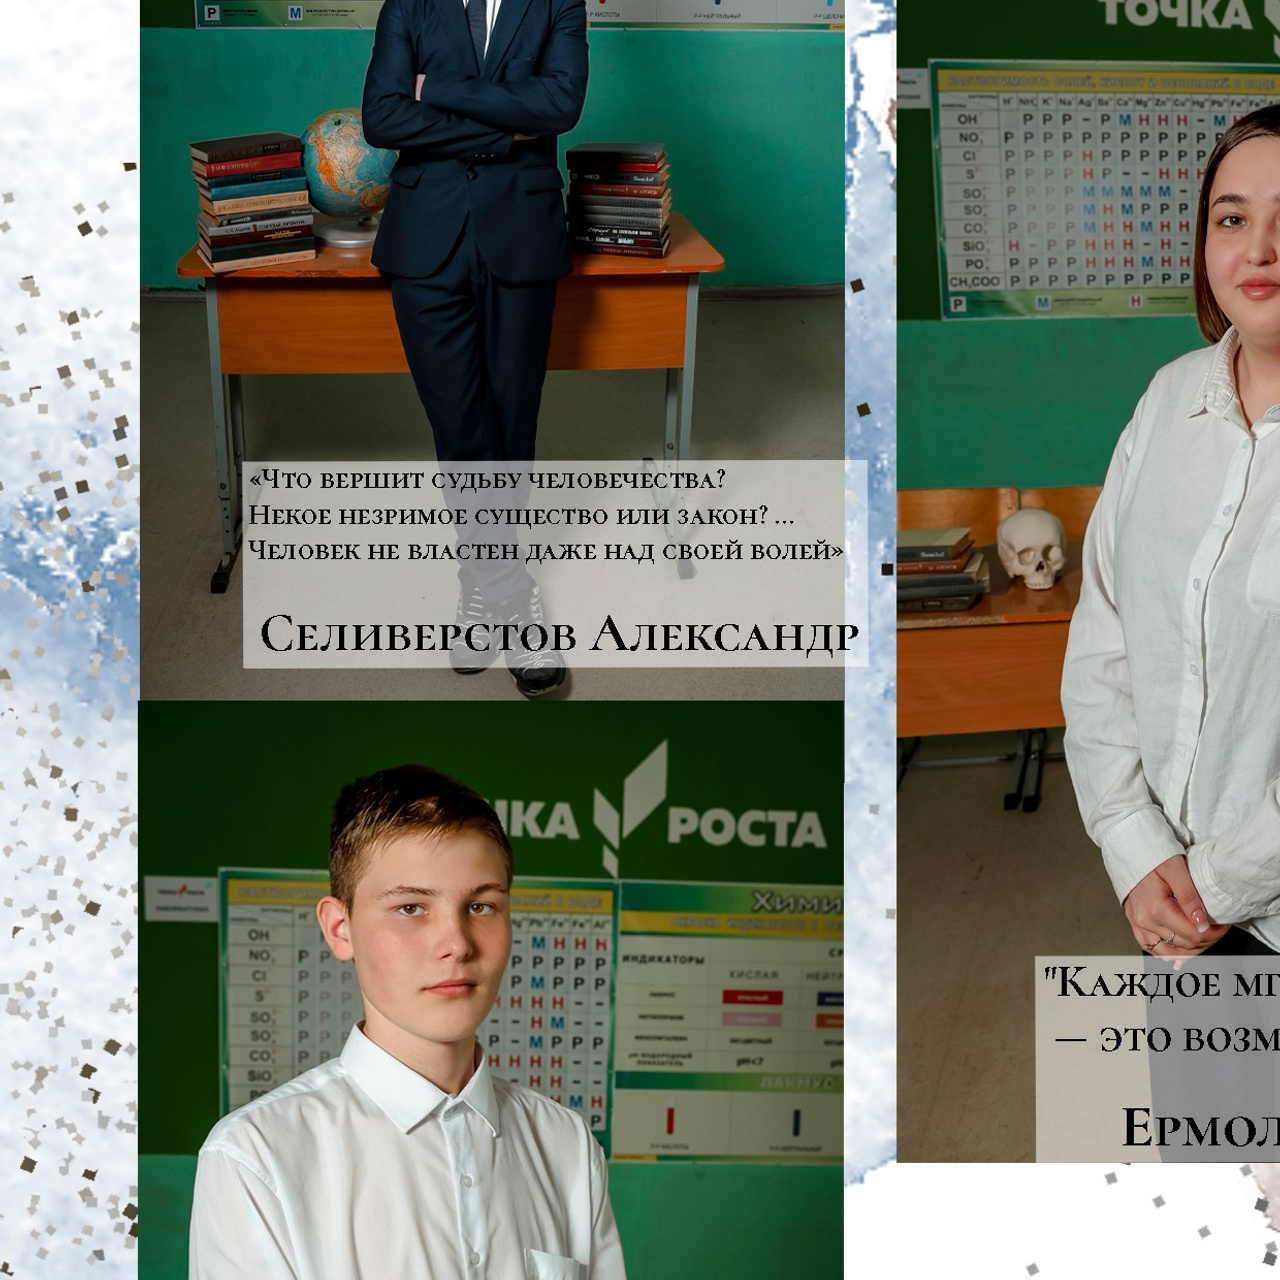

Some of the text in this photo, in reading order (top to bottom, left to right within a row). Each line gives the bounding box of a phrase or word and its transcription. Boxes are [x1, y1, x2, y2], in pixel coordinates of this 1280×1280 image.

[1097, 0, 1253, 30] ТОЧКА
[669, 807, 828, 848] РОСТА
[752, 891, 844, 914] Хими
[622, 954, 705, 965] ИНДИКАТОРЫ
